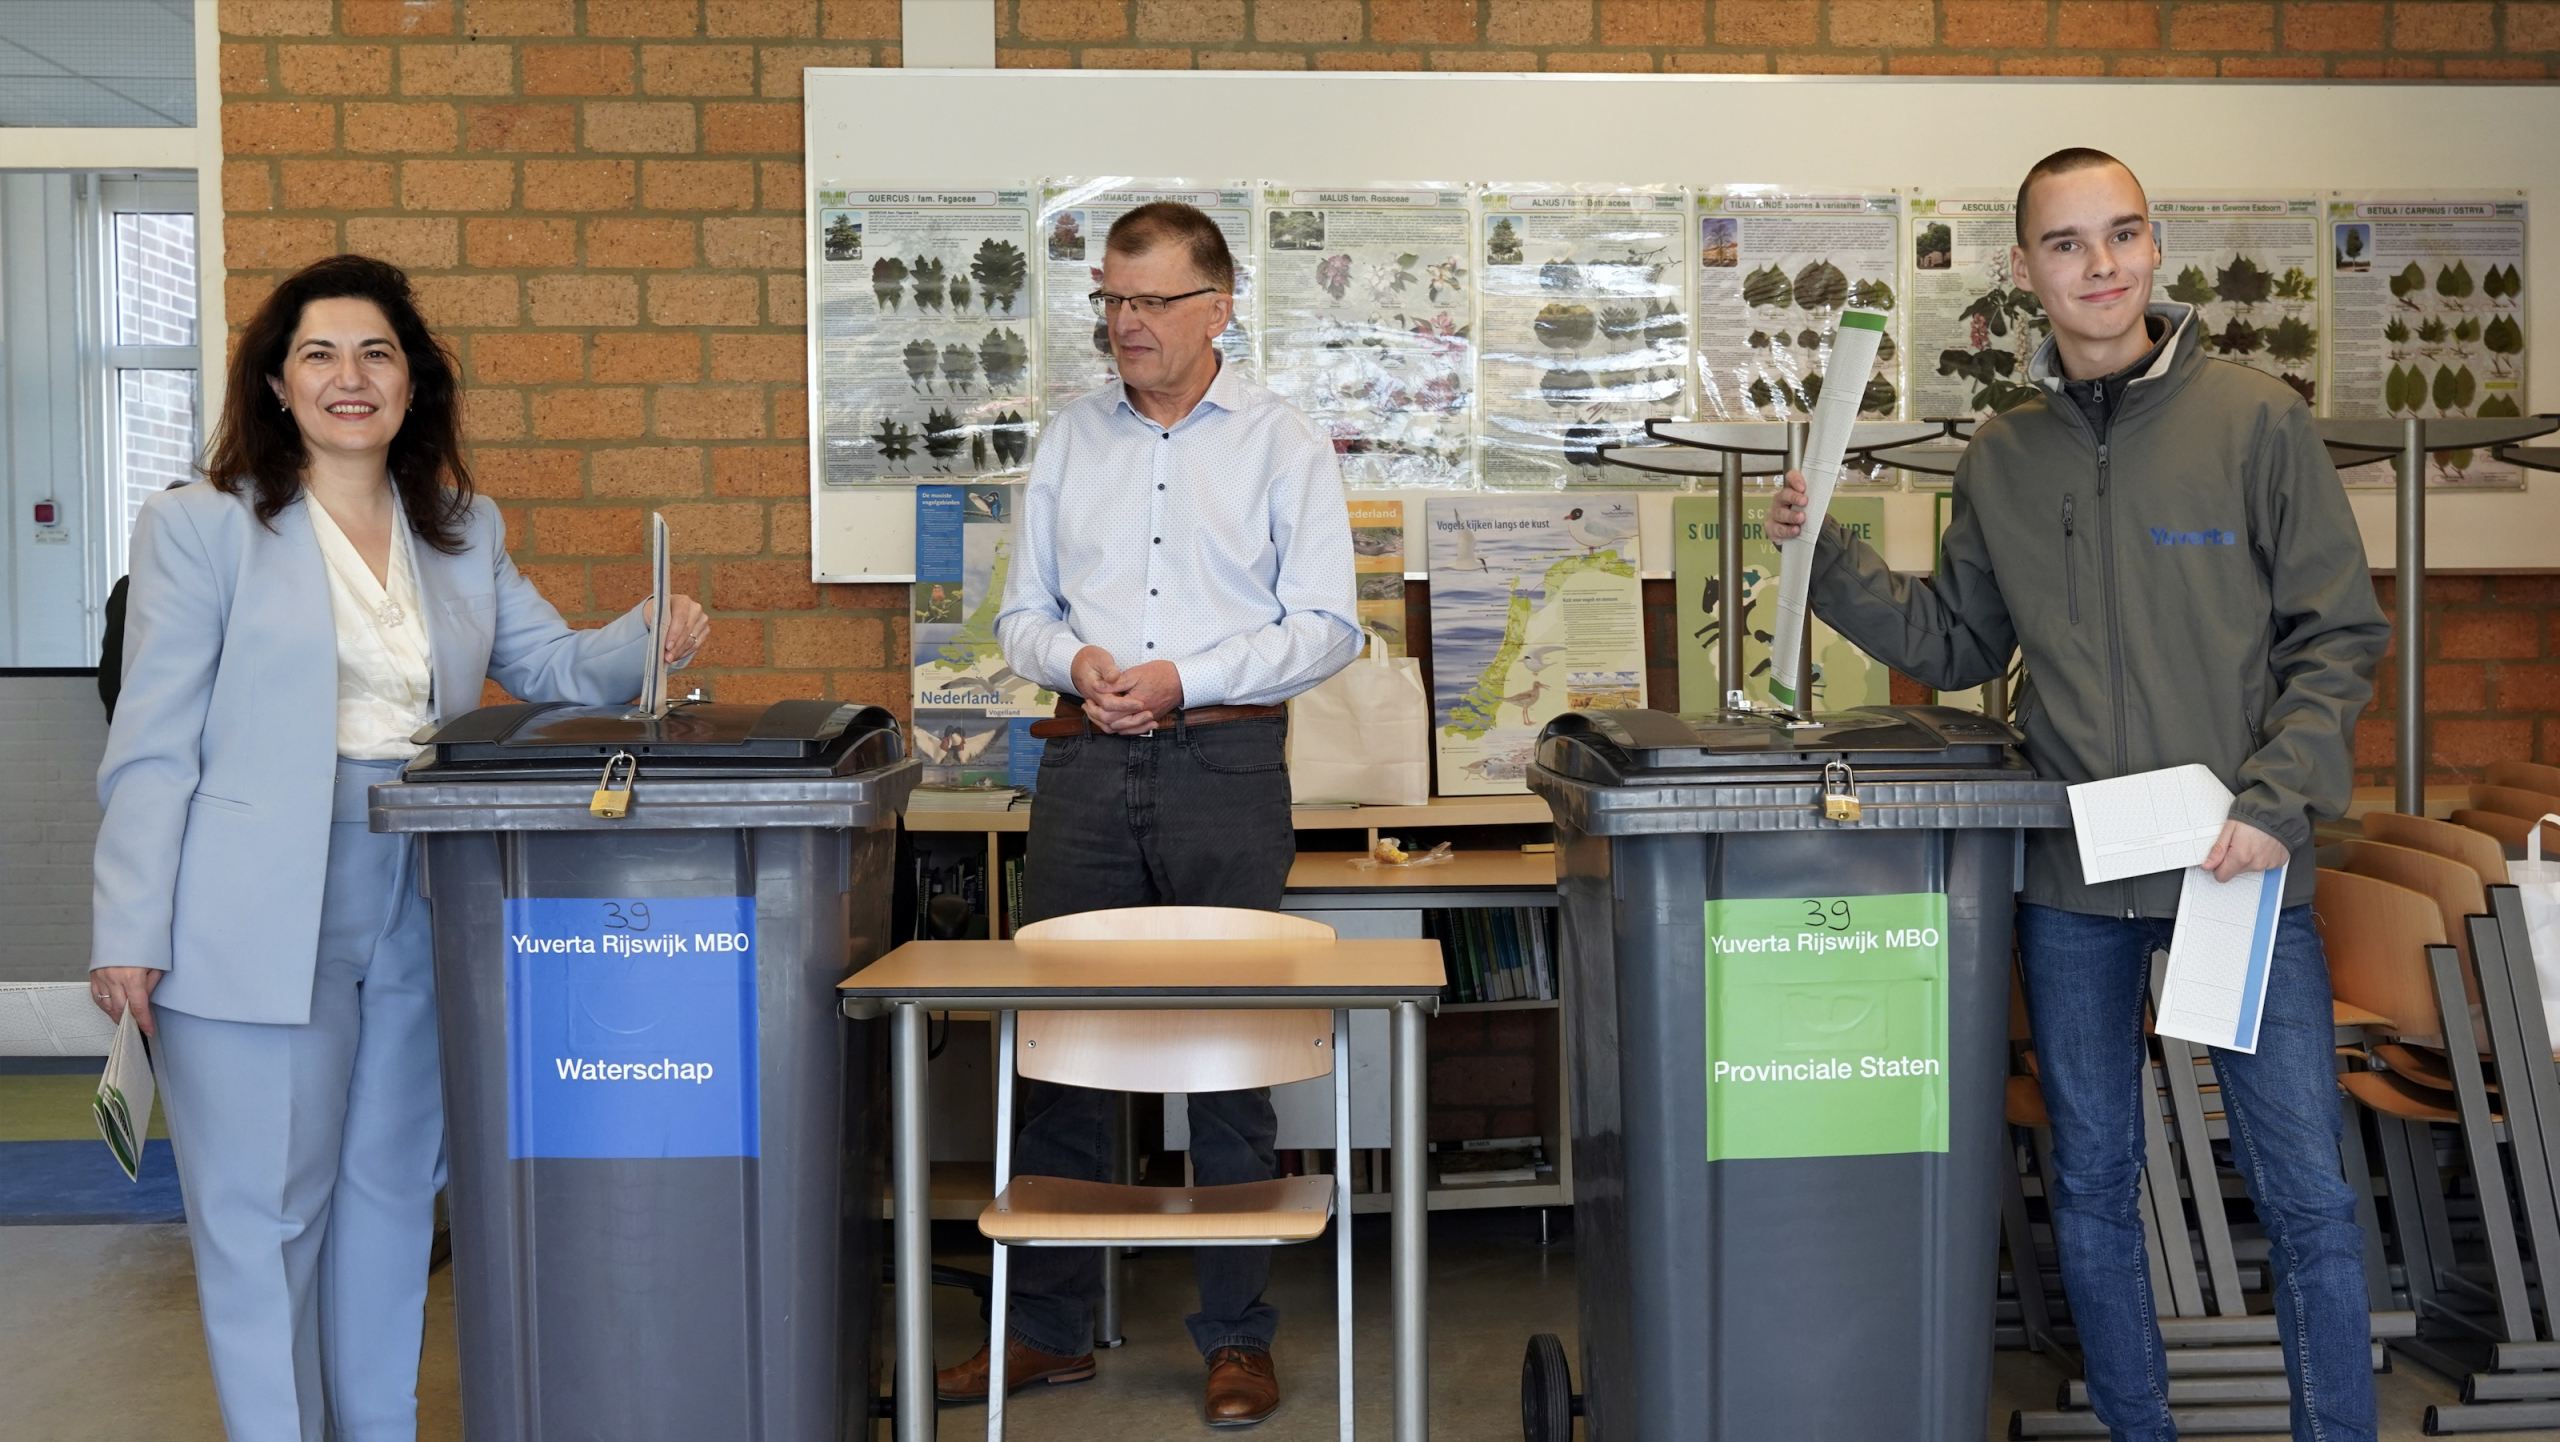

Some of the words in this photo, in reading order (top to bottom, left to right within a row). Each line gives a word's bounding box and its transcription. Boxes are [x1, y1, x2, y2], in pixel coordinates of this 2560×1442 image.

[868, 194, 910, 203] QUERCUS
[917, 194, 935, 203] fam.
[938, 194, 976, 204] Fagaceae
[1136, 195, 1151, 203] aan
[1153, 194, 1163, 202] de
[1166, 194, 1199, 204] HERFST
[1319, 194, 1349, 202] MALUS
[1351, 194, 1369, 203] fam.
[1371, 194, 1410, 203] Rosaceae
[1532, 198, 1560, 207] ALNUS
[1587, 199, 1631, 208] Betulaceae
[1730, 201, 1750, 209] TILIA
[1785, 201, 1813, 209] soorten
[1815, 201, 1821, 209] &
[1962, 203, 2005, 212] AESCULUS
[2153, 203, 2173, 212] ACER
[2180, 203, 2205, 212] Noorse
[2222, 203, 2250, 212] Gewone
[2252, 203, 2281, 212] Esdoorn
[2367, 207, 2398, 215] BETULA
[2405, 207, 2446, 215] CARPINUS
[2453, 207, 2484, 215] OSTRYA
[1349, 508, 1397, 519] ederland
[1437, 520, 1465, 532] Vogels
[1466, 519, 1493, 532] kijken
[1494, 519, 1518, 531] langs
[1519, 518, 1530, 529] de
[1531, 518, 1550, 529] kust
[2150, 527, 2235, 546] Yuverta
[921, 690, 1014, 705] Nederland...
[988, 708, 1021, 717] Vogelland
[602, 901, 651, 931] 39
[1802, 899, 1852, 931] 39
[511, 935, 596, 953] Yuverta
[602, 934, 688, 957] Rijswijk
[695, 932, 749, 952] MBO
[1711, 935, 1791, 954] Yuverta
[1798, 931, 1879, 955] Rijswijk
[1885, 928, 1939, 948] MBO
[555, 1058, 713, 1084] Waterschap
[1714, 1058, 1852, 1083] Provinciale
[1860, 1056, 1940, 1078] Staten
